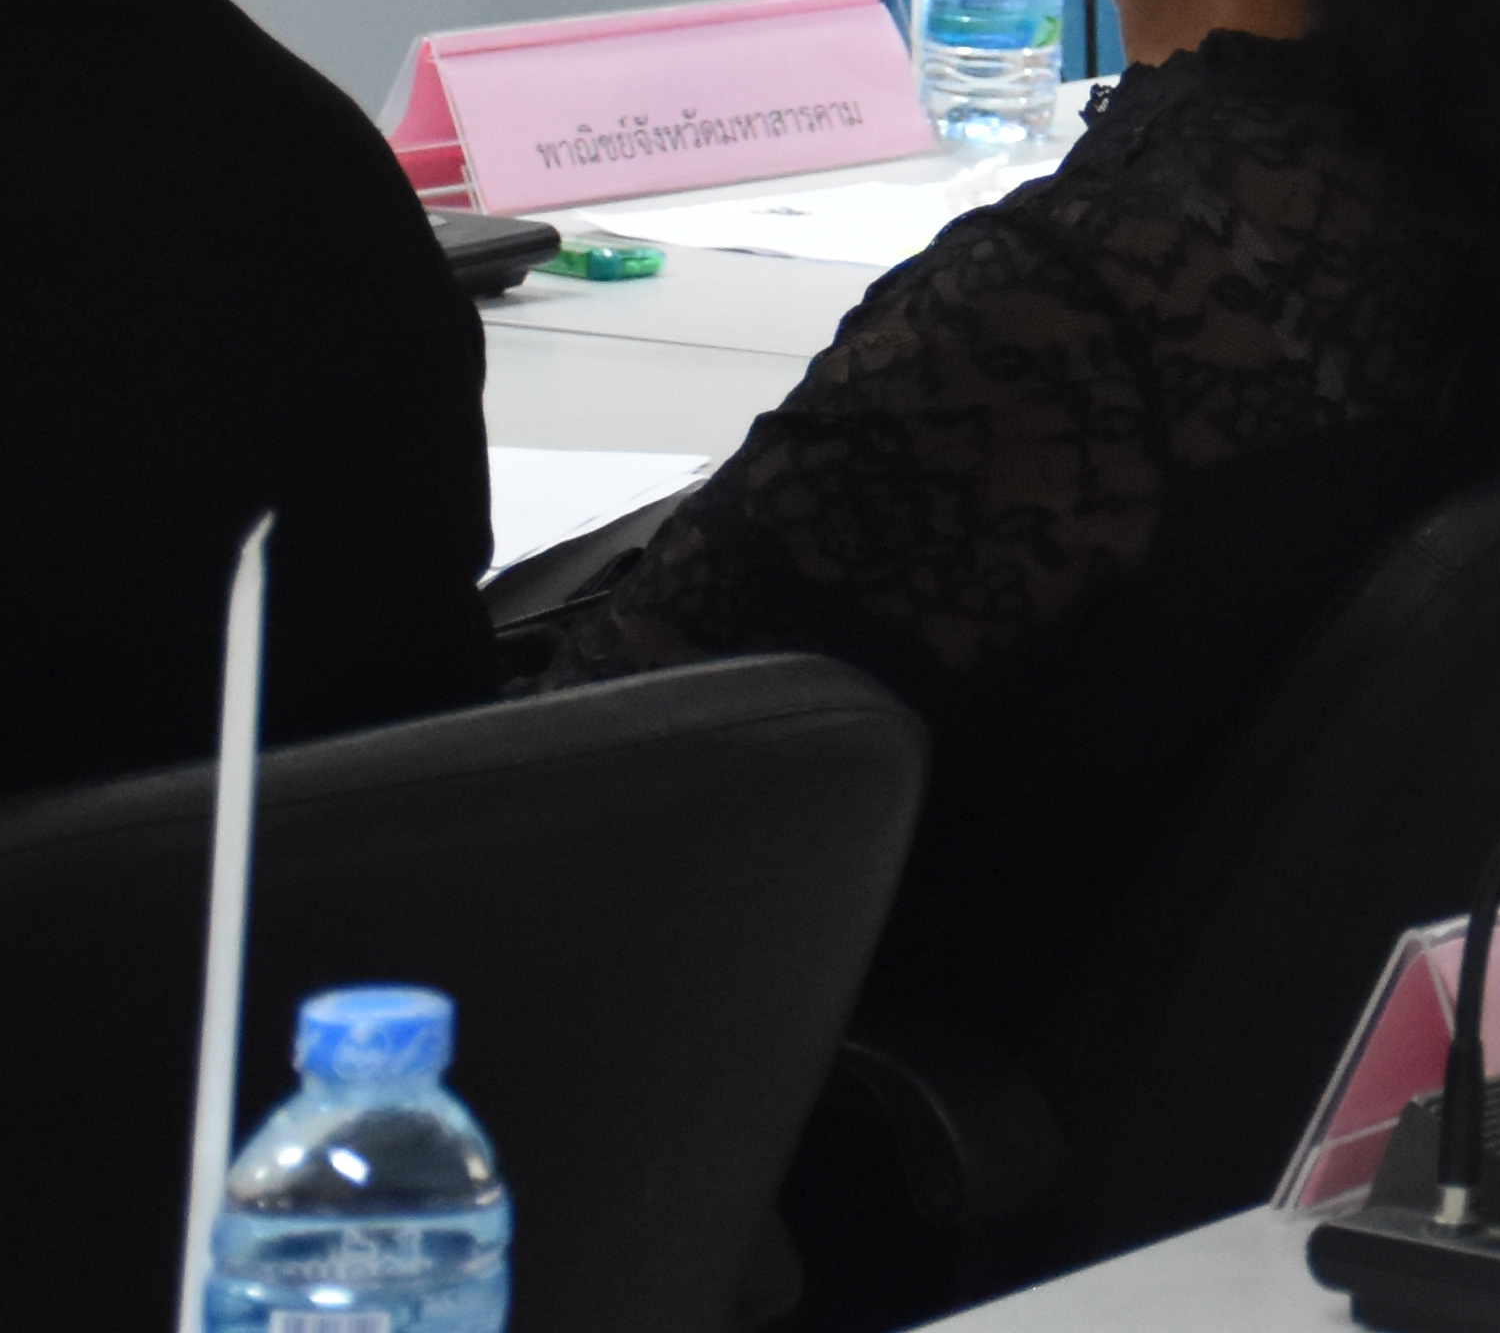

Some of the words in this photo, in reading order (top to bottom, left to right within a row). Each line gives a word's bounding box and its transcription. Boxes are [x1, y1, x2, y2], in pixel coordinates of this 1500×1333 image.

[536, 99, 863, 170] พาณิชย์จังหวัดมหาสารคาม
